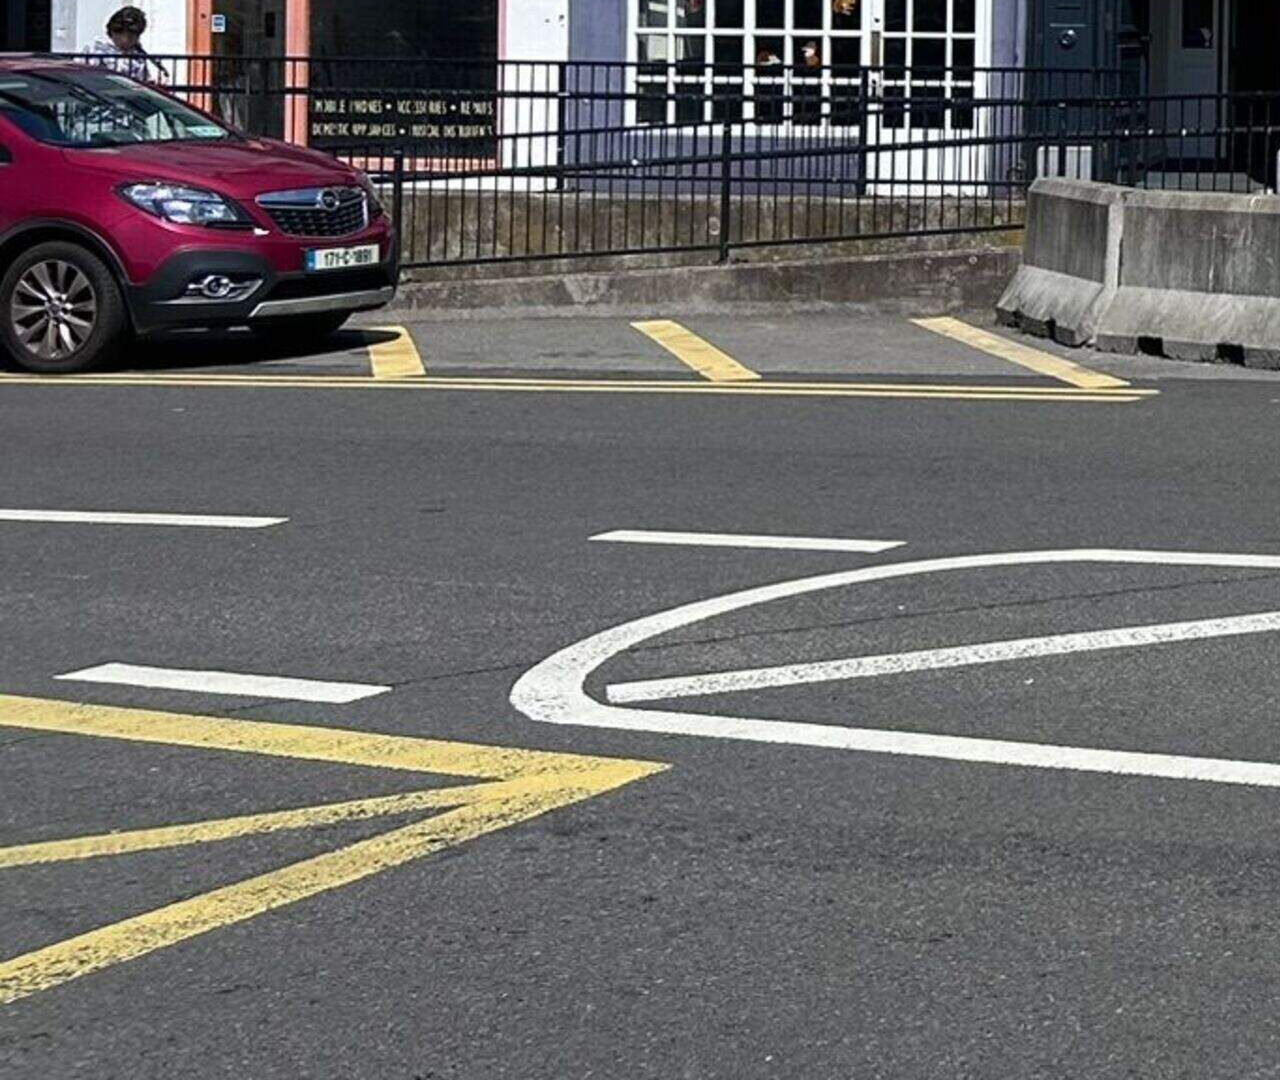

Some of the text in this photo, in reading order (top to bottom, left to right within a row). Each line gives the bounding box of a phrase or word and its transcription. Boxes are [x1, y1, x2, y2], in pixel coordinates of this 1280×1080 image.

[313, 100, 346, 113] MOBIE
[397, 100, 447, 115] ACCSSORIES
[460, 101, 493, 116] REAIRS
